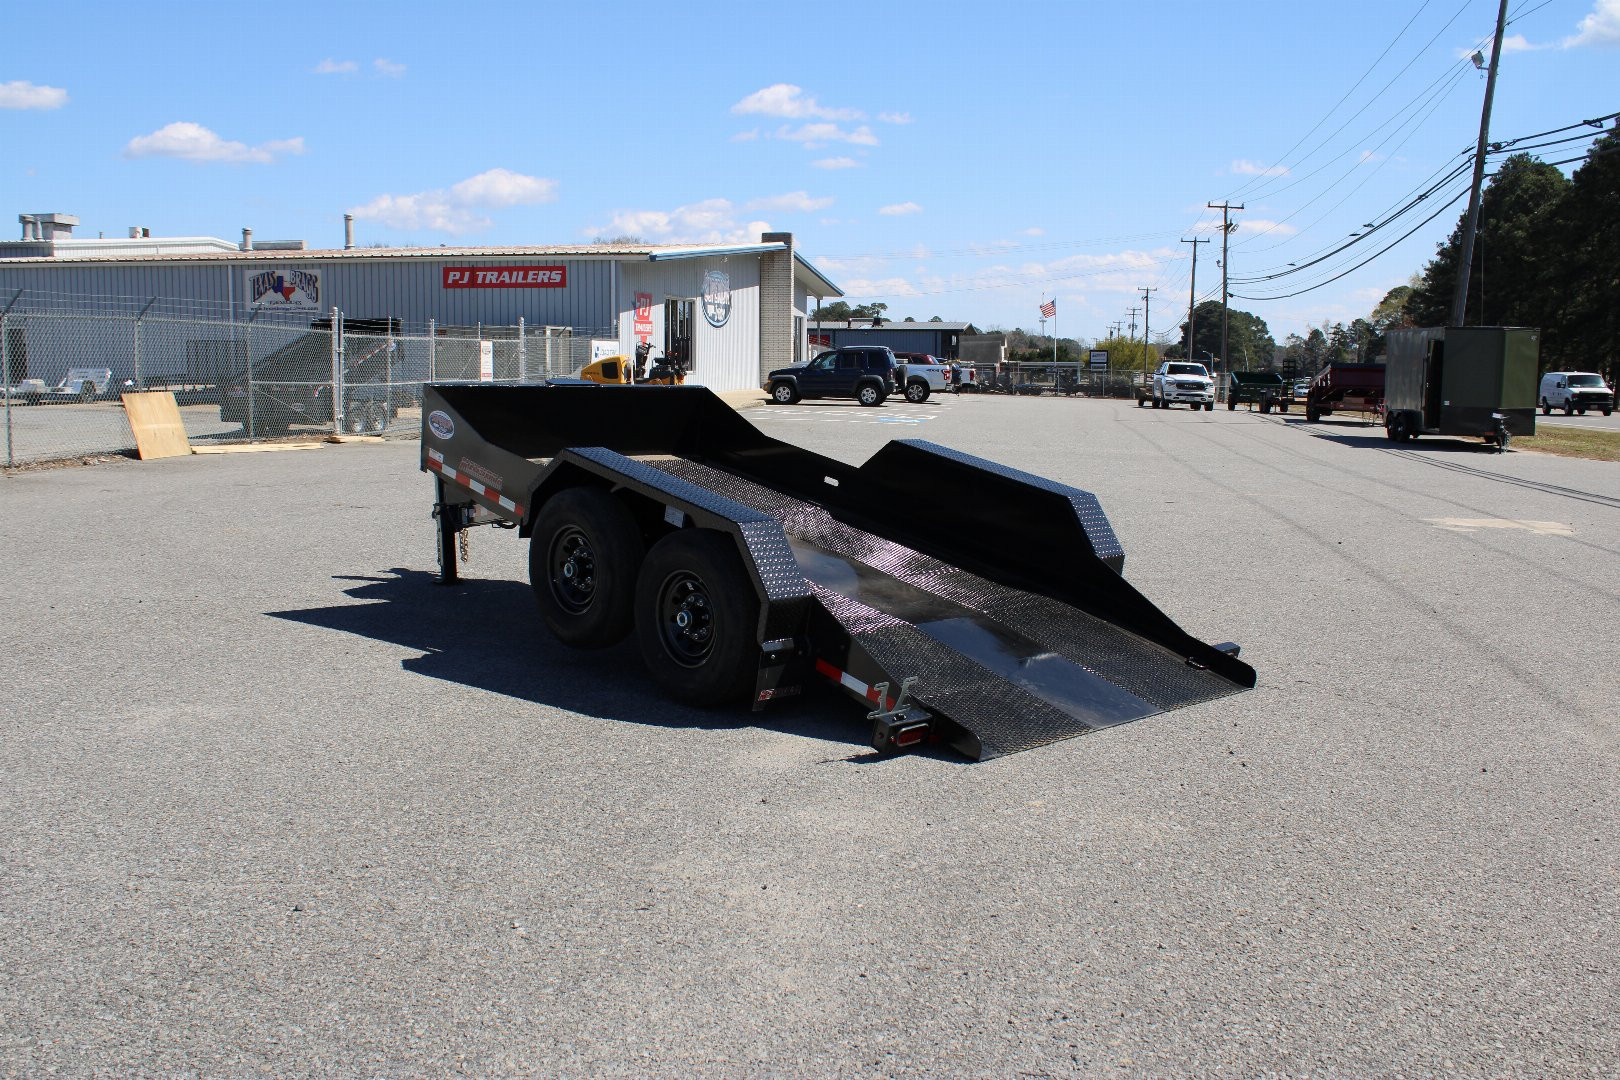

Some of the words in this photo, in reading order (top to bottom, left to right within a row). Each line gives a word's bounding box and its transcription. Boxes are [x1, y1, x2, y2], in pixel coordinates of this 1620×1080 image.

[249, 270, 277, 303] TEXAS
[290, 270, 319, 304] BRAGG
[447, 271, 470, 284] PJ
[475, 270, 563, 284] TRAILERS
